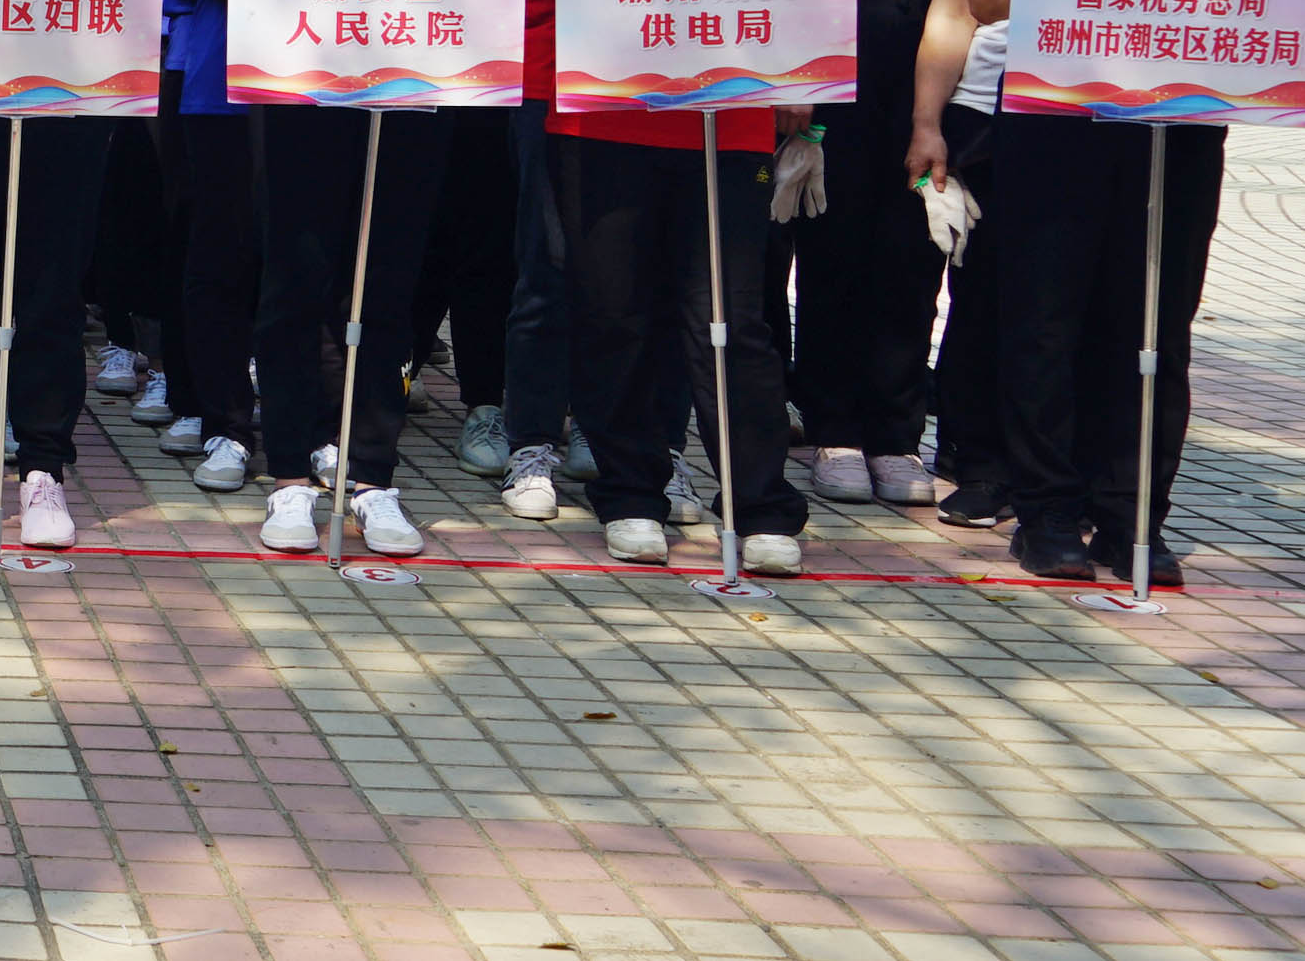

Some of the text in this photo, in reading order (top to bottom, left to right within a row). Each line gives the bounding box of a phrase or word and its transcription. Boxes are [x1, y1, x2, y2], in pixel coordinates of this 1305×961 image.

[286, 10, 465, 46] 人民法院
[639, 8, 772, 48] 供电局
[1037, 19, 1301, 66] 潮州市潮安区税务局
[16, 557, 52, 569] 4
[363, 568, 396, 582] 3
